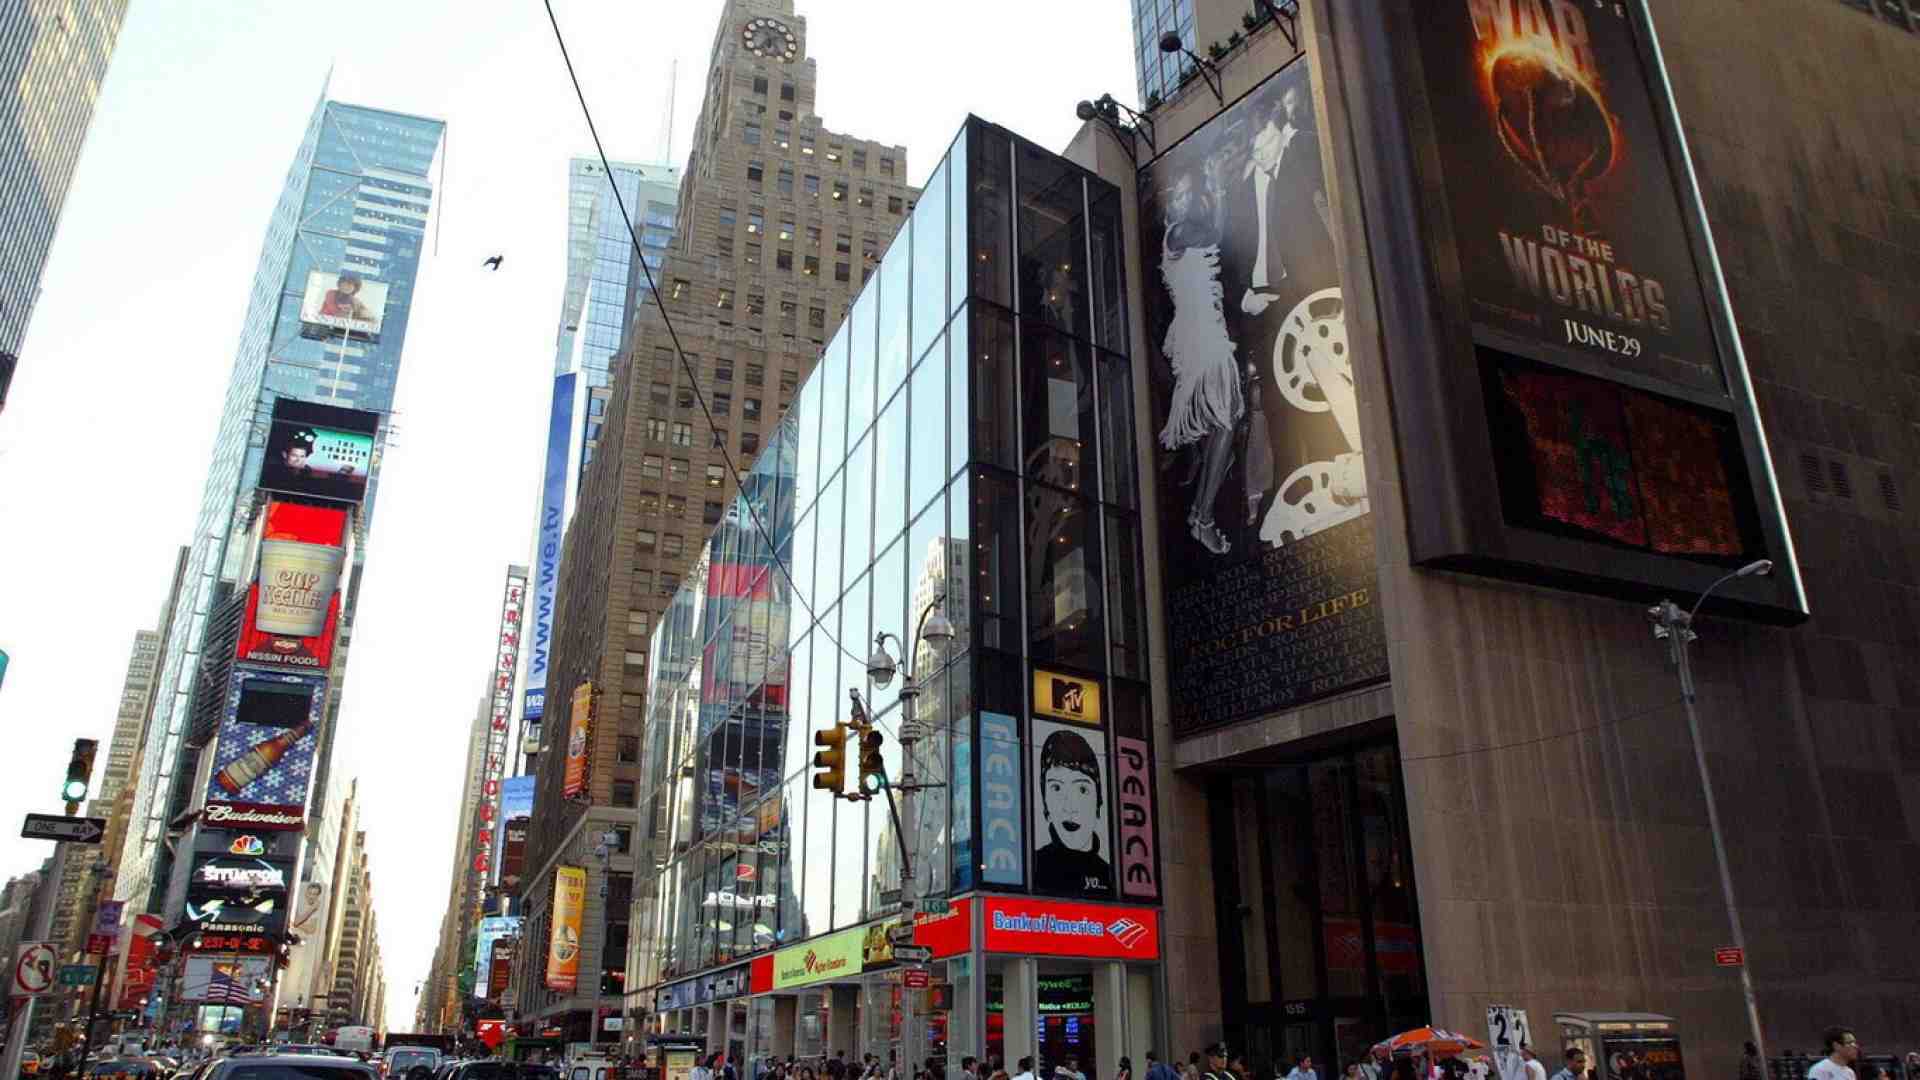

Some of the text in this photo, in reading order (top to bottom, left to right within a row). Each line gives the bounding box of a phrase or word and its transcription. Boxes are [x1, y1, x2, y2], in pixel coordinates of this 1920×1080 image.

[1541, 224, 1616, 263] OF THE
[1499, 231, 1668, 330] WORLDS
[1563, 319, 1641, 358] JUNE 29
[533, 506, 558, 674] www.we.tv
[1242, 615, 1295, 643] FOR
[1300, 588, 1369, 625] LIFE
[284, 655, 320, 666] FOODS
[1052, 678, 1088, 713] MTV
[34, 822, 57, 832] ONE
[206, 805, 305, 824] Budweiser
[200, 921, 264, 932] Panasonic
[993, 910, 1104, 936] Bank of America
